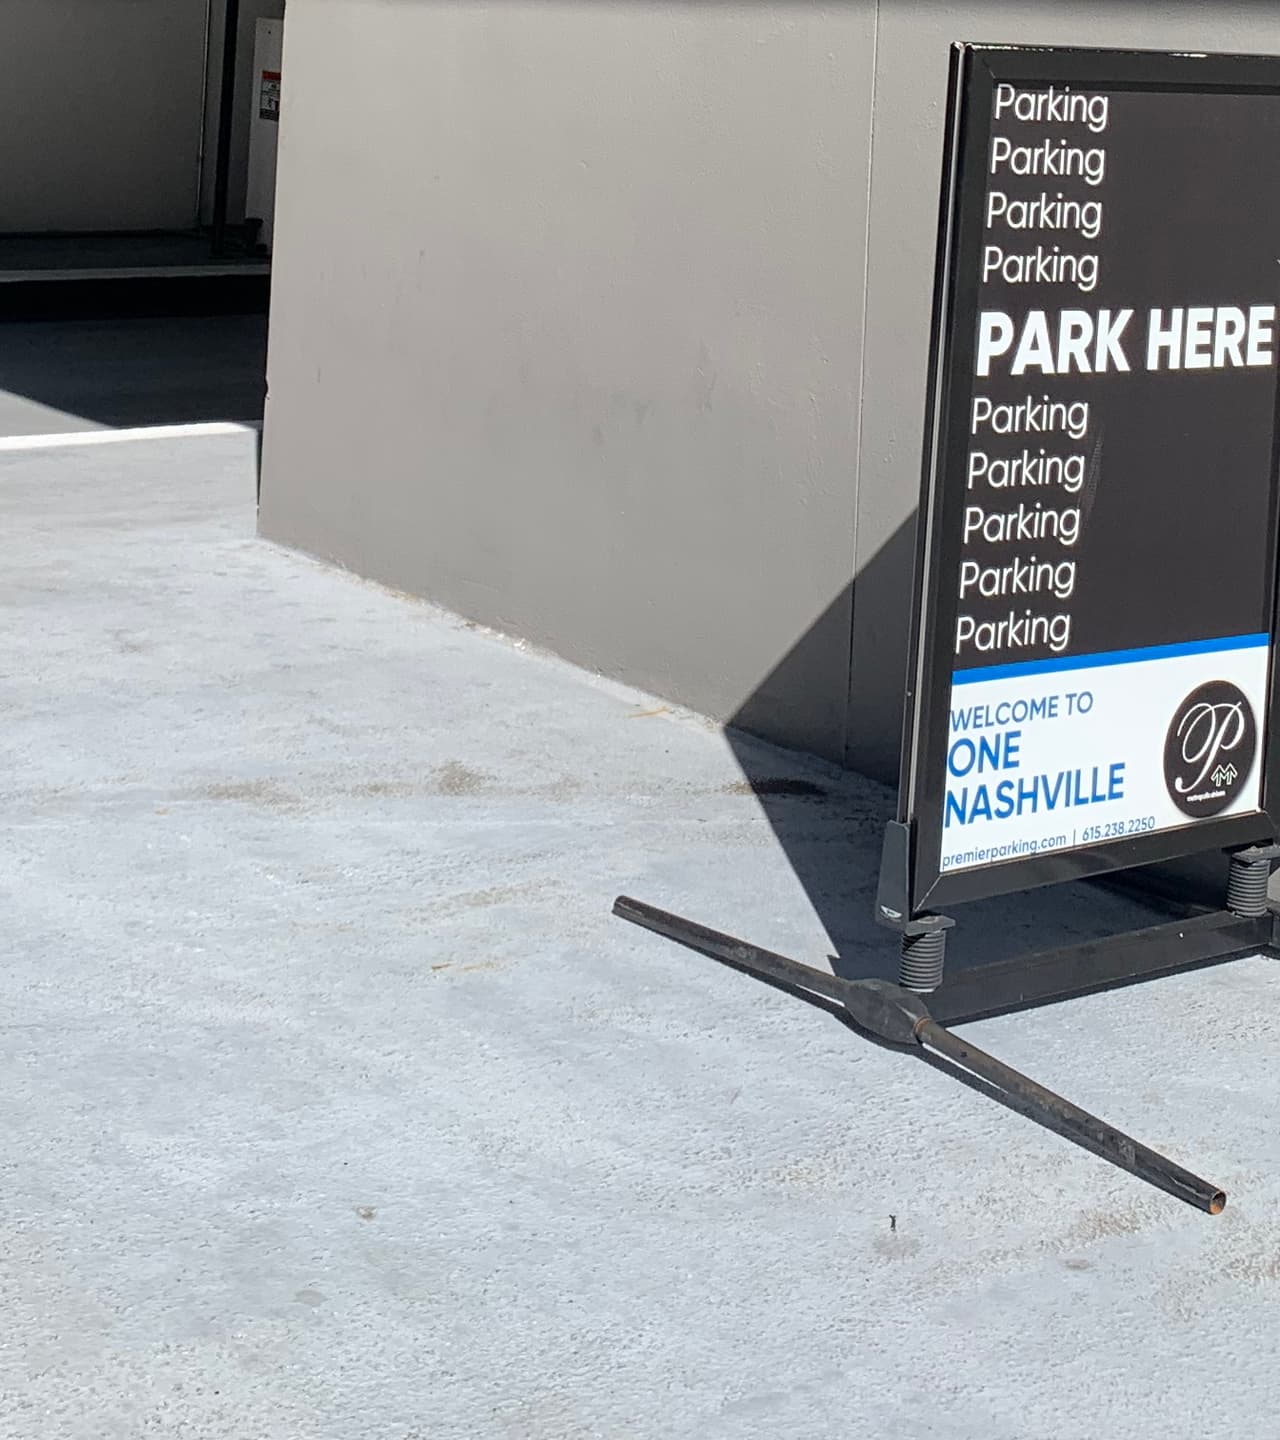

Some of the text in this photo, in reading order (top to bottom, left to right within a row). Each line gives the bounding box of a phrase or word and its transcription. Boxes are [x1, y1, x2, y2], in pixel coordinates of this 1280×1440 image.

[994, 83, 1109, 133] Parking
[990, 137, 1106, 186] Parking
[986, 190, 1102, 239] Parking
[982, 245, 1099, 292] Parking
[976, 305, 1276, 377] PARK HERE
[971, 395, 1089, 440] Parking
[967, 448, 1085, 493] Parking
[963, 502, 1080, 546] Parking
[959, 556, 1076, 599] Parking
[955, 609, 1071, 655] Parking
[950, 690, 1094, 732] WELCOME TO
[947, 730, 1022, 778] ONE
[944, 762, 1126, 829] NASHVILLE
[942, 833, 1066, 870] premierparking.com
[1082, 816, 1155, 842] 615.238.2250
